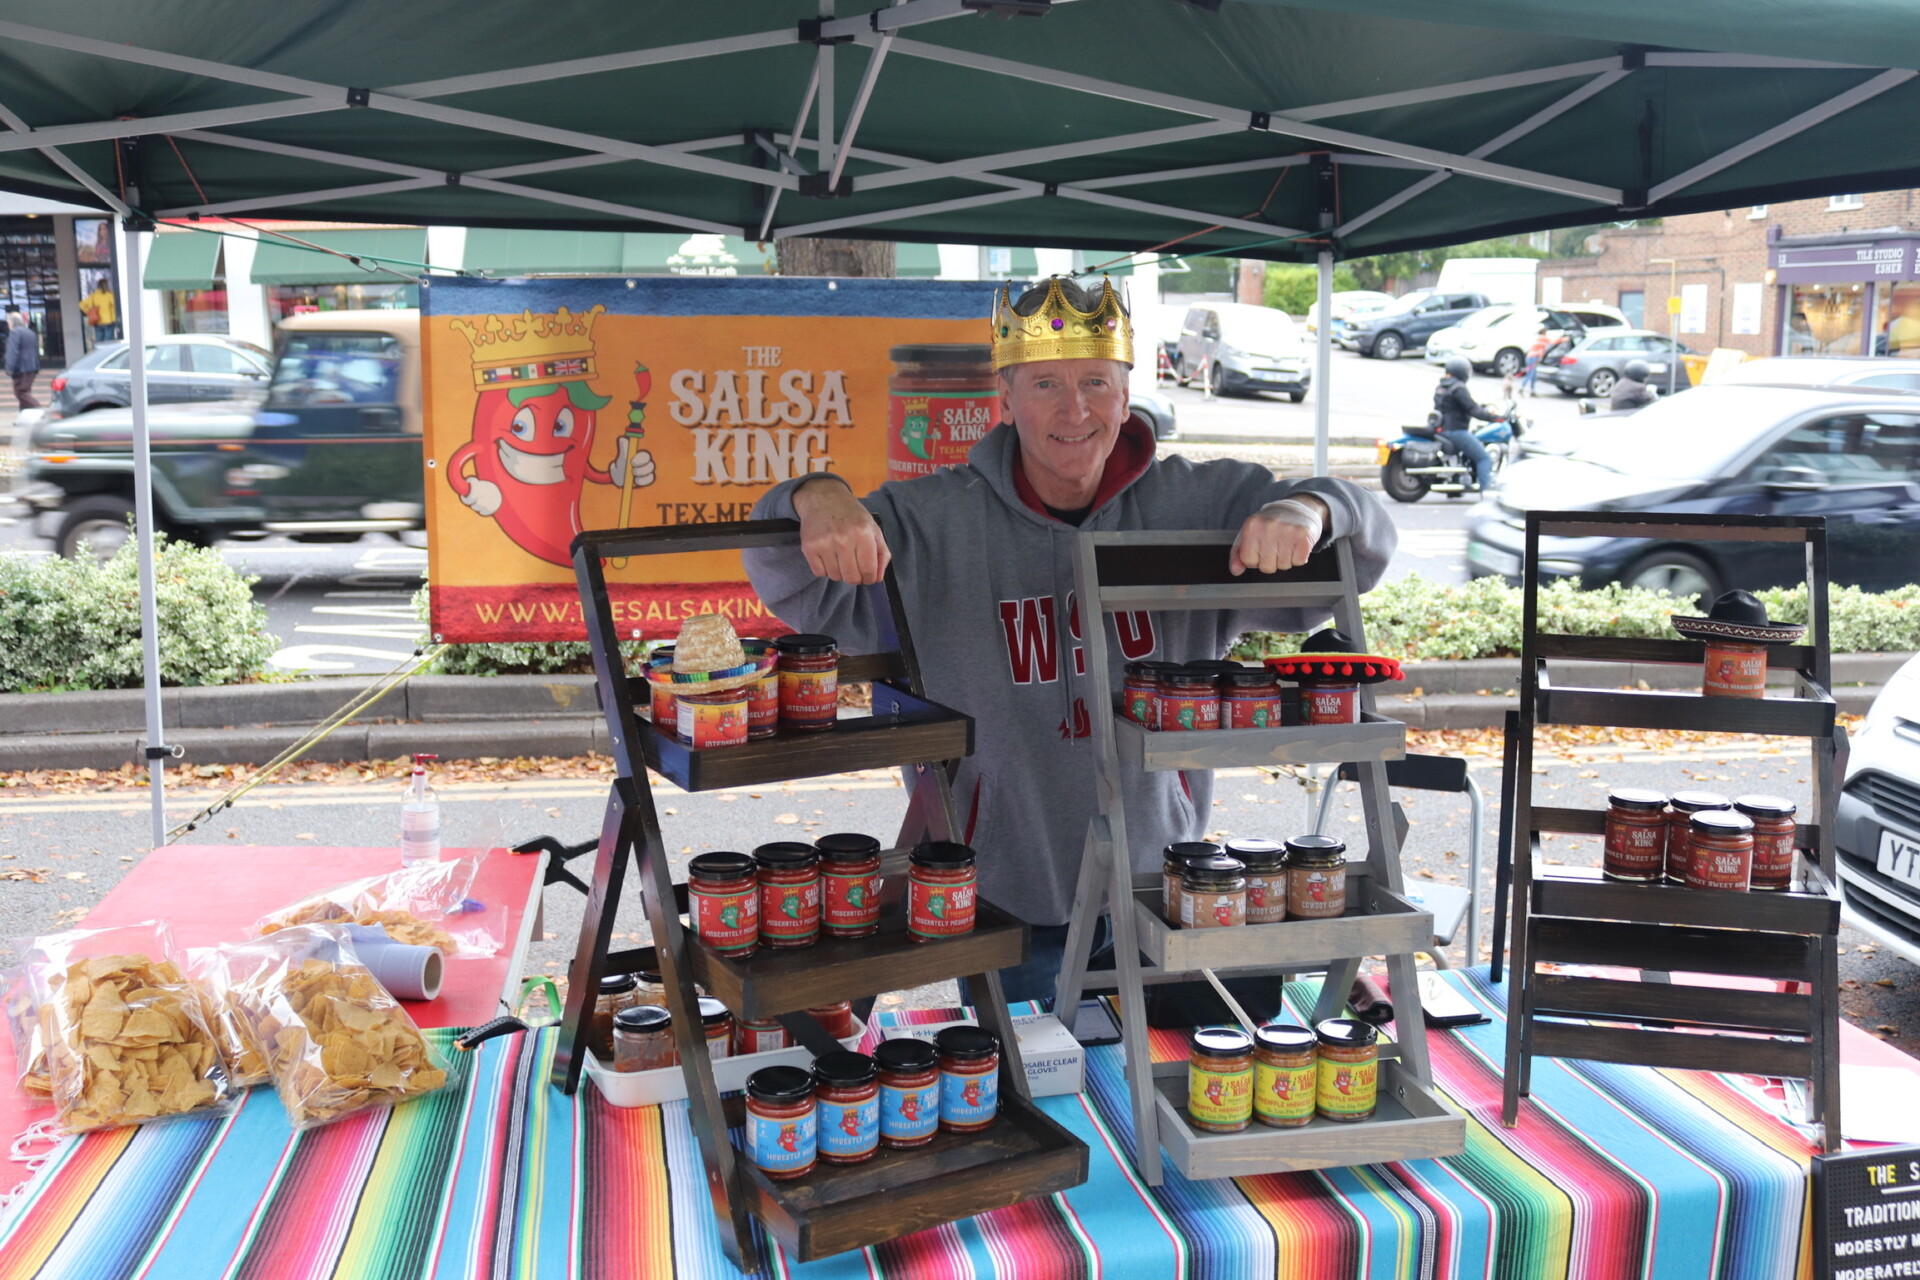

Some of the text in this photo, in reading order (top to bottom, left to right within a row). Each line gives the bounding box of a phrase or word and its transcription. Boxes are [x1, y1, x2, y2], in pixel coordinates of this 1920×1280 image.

[1856, 250, 1873, 260] TILE
[1874, 248, 1904, 260] STUDIO
[1875, 263, 1902, 274] ESHER
[742, 346, 781, 367] THE
[668, 369, 855, 428] SALSA
[944, 408, 991, 425] SALSA
[950, 424, 985, 442] KING
[690, 428, 835, 487] KING
[656, 503, 757, 525] TEX-ME
[1315, 697, 1341, 706] SALSA
[786, 704, 820, 712] INTENSELY
[1319, 705, 1339, 714] KING
[1632, 831, 1657, 840] SALSA
[1635, 839, 1654, 847] KING
[1715, 856, 1741, 865] SALSA
[1891, 839, 1920, 878] YT
[1718, 865, 1738, 873] KING
[1708, 880, 1733, 888] SWEET
[952, 887, 973, 902] SALSA
[956, 899, 972, 909] KING
[1301, 901, 1327, 909] COWBOY
[1246, 907, 1268, 915] OWBOY
[767, 919, 803, 927] MODERATELY
[914, 916, 949, 927] MODERATELY
[705, 930, 743, 938] MODERATELY
[1023, 1057, 1078, 1069] OSABLE CLEAR
[1027, 1066, 1057, 1075] GLOVES
[951, 1107, 983, 1115] MODESTLY
[889, 1121, 922, 1129] MODESTLY
[829, 1136, 862, 1145] MODESTLY
[767, 1152, 800, 1161] MODESTLY
[1867, 1164, 1898, 1186] THE
[1834, 1235, 1907, 1257] MODESTLY
